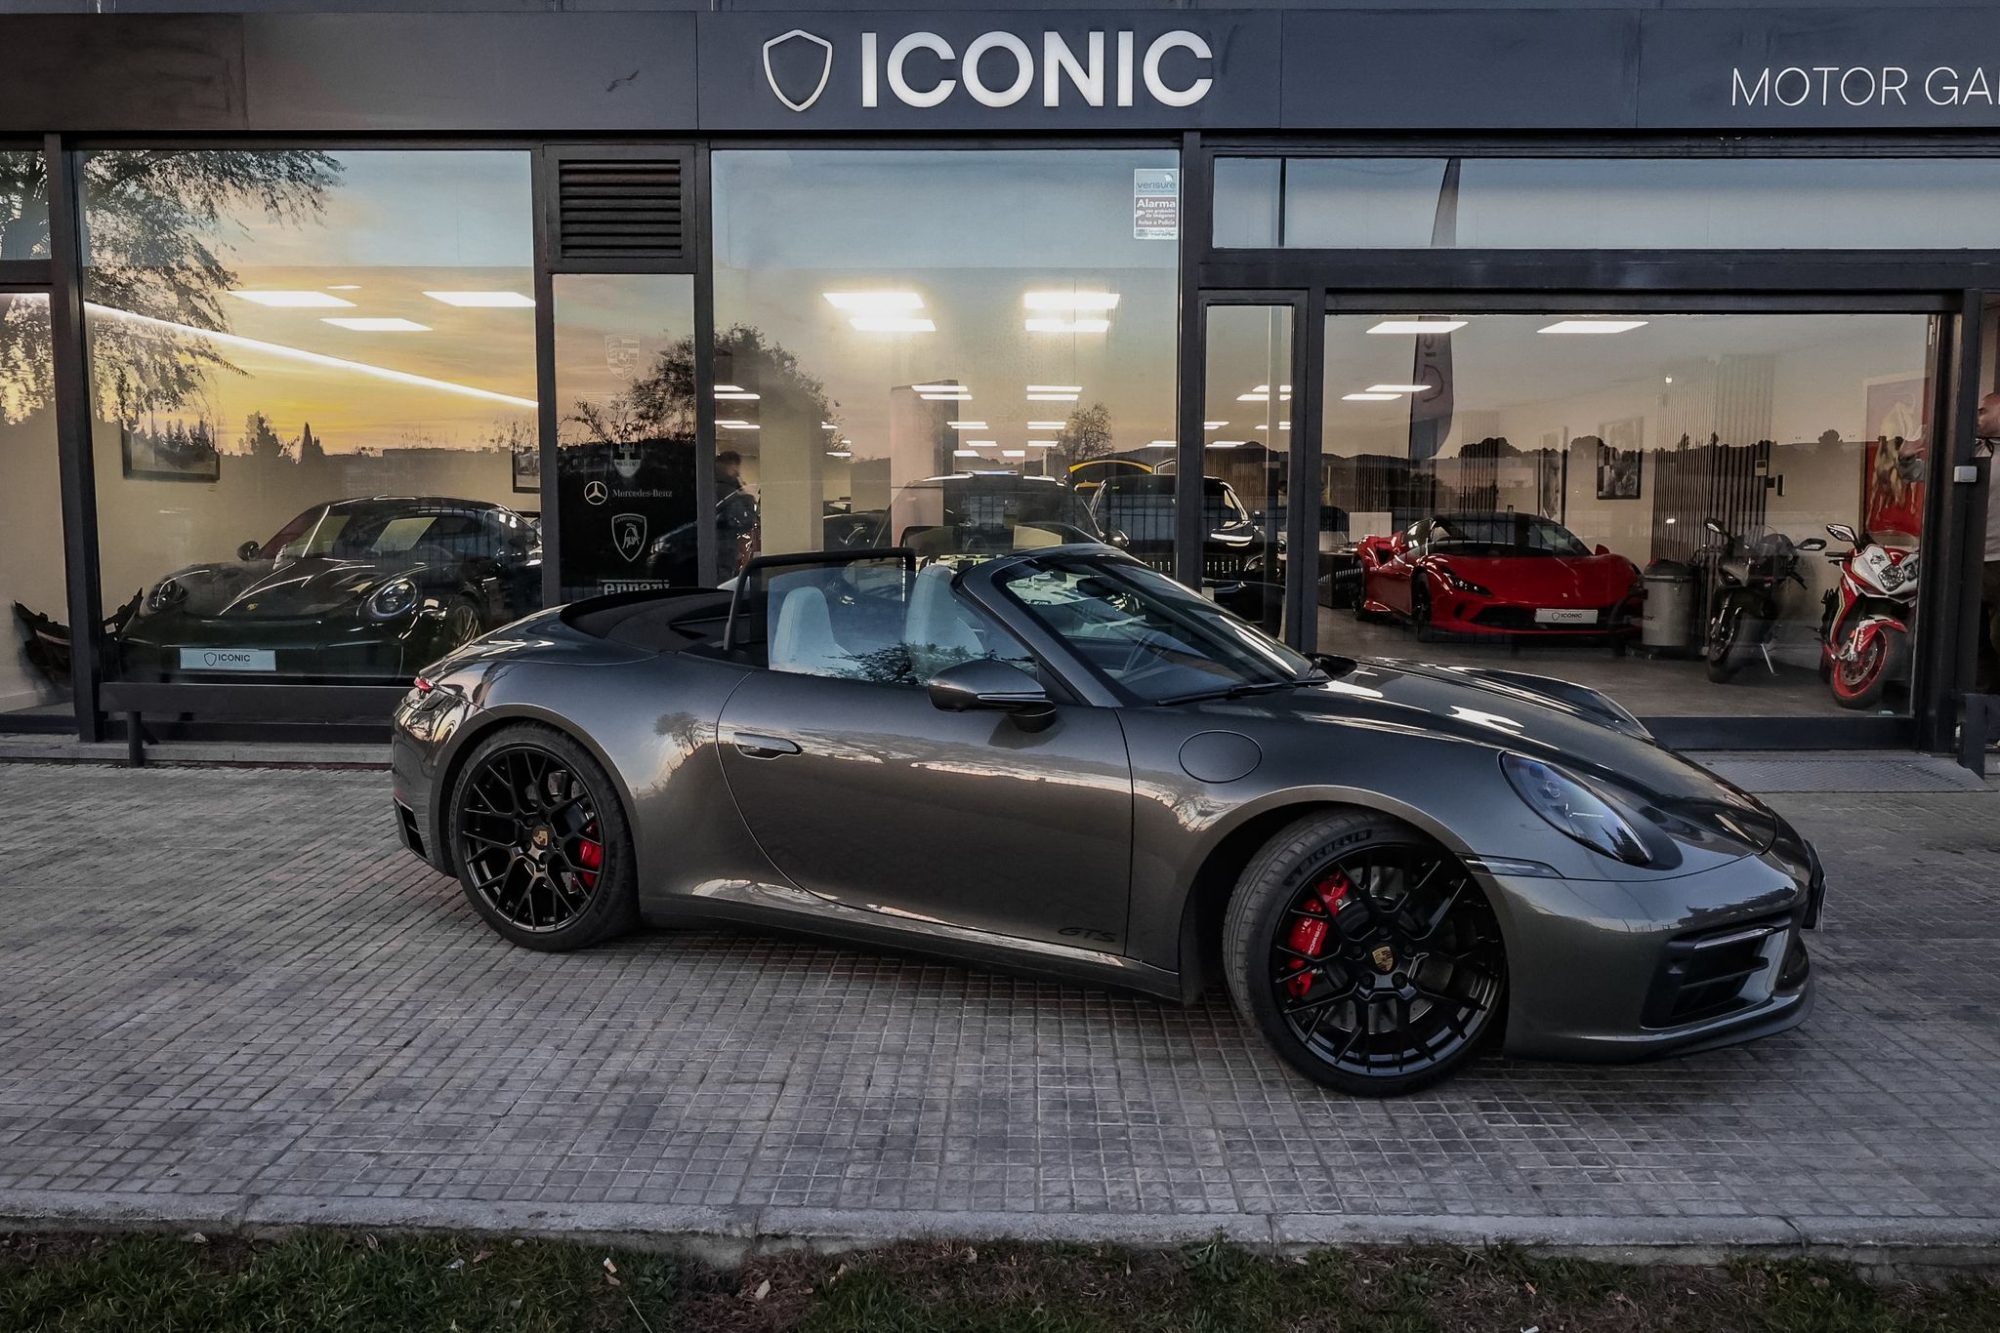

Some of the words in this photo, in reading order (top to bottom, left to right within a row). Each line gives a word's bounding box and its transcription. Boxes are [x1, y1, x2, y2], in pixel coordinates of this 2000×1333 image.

[861, 30, 1213, 108] ICONIC
[1731, 66, 1908, 106] MOTOR
[1925, 66, 2000, 106] GA
[1137, 180, 1176, 189] verisure
[1137, 198, 1176, 208] Alarma
[612, 488, 673, 498] Mercedes-Benz
[218, 653, 251, 662] ICONIC
[1058, 926, 1116, 943] GTS
